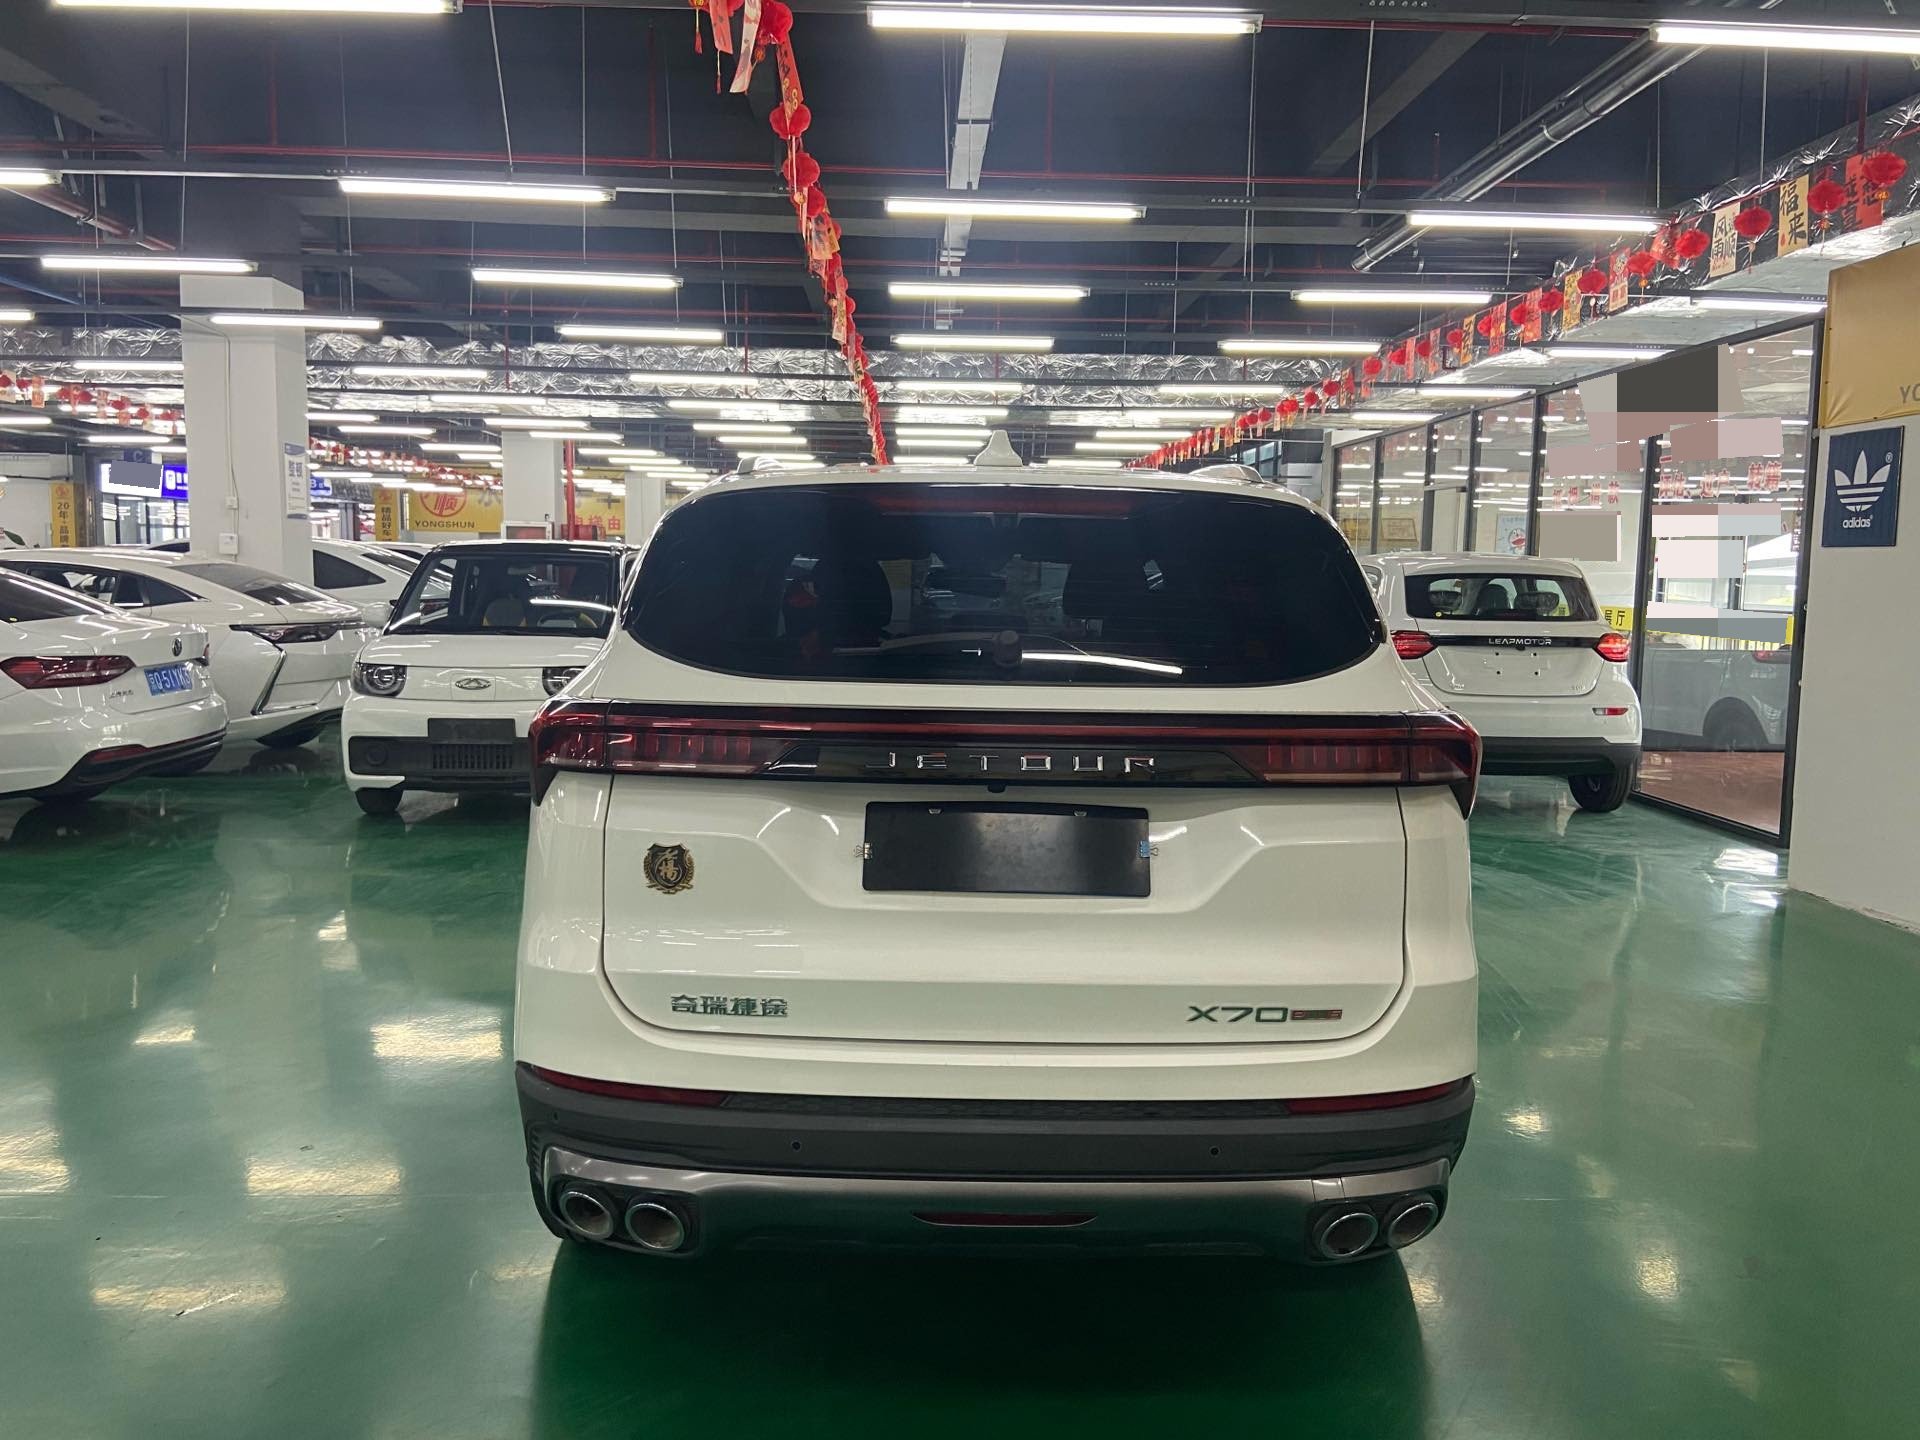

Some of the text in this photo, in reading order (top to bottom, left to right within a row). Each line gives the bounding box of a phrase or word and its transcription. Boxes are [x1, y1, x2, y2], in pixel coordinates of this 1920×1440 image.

[1779, 181, 1807, 246] 福来
[415, 520, 475, 529] YONGSHUN
[1842, 516, 1871, 529] adidas
[1488, 638, 1552, 646] LEAPMOTOR
[884, 752, 1155, 774] JETOUR
[671, 994, 788, 1017] 奇瑞捷途
[1186, 1005, 1289, 1023] X70
